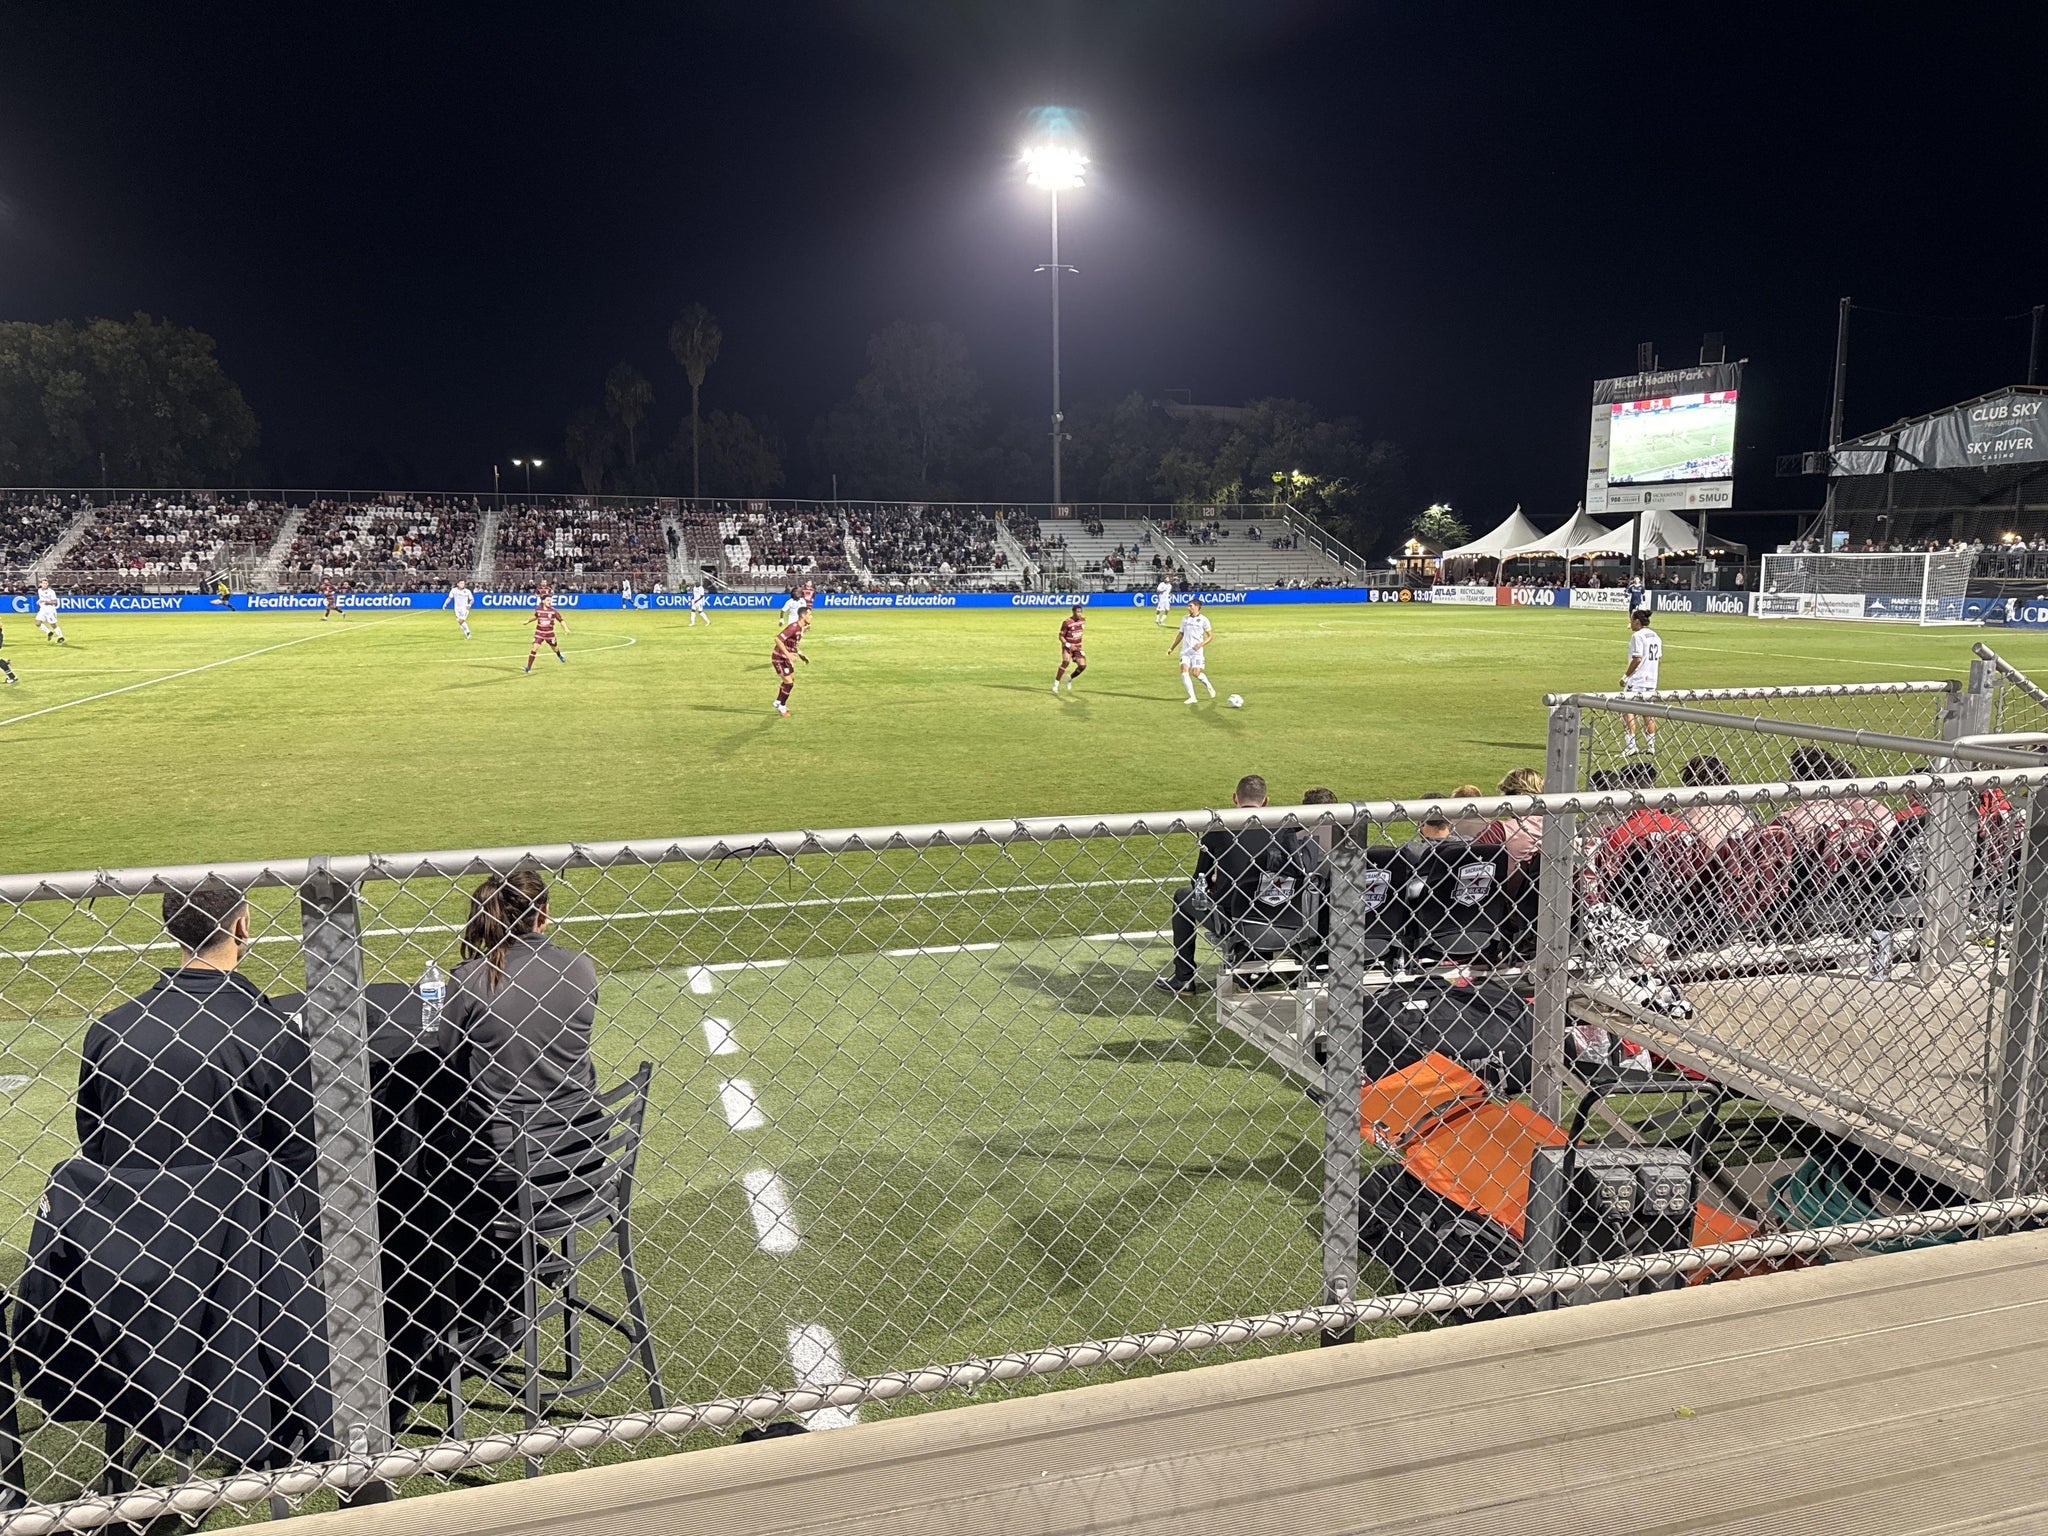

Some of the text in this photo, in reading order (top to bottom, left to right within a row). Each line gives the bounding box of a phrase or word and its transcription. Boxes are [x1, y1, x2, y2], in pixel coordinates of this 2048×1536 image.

[1614, 369, 1704, 390] Heart Health Park
[1972, 402, 2041, 421] CLUB SKY
[1967, 437, 2033, 454] SKY RIVER
[1981, 452, 2014, 460] CASINO
[1698, 493, 1729, 503] SMUD
[751, 502, 763, 511] 117
[1058, 506, 1069, 517] 119
[1202, 507, 1215, 517] 120
[1198, 593, 1247, 603] ACADEMY
[1382, 590, 1432, 602] 0-0 13:07
[1434, 588, 1457, 597] ATLAS
[1511, 588, 1555, 605] FOX40
[1576, 591, 1608, 602] POWER
[110, 597, 183, 609] ACADEMY
[336, 594, 411, 606] Education
[713, 596, 773, 606] ACADEMY
[825, 594, 956, 606] Healthcare Education
[1012, 594, 1090, 605] GURNICK.EDU
[1657, 594, 1692, 611] Modelo
[1706, 595, 1744, 613] Modelo
